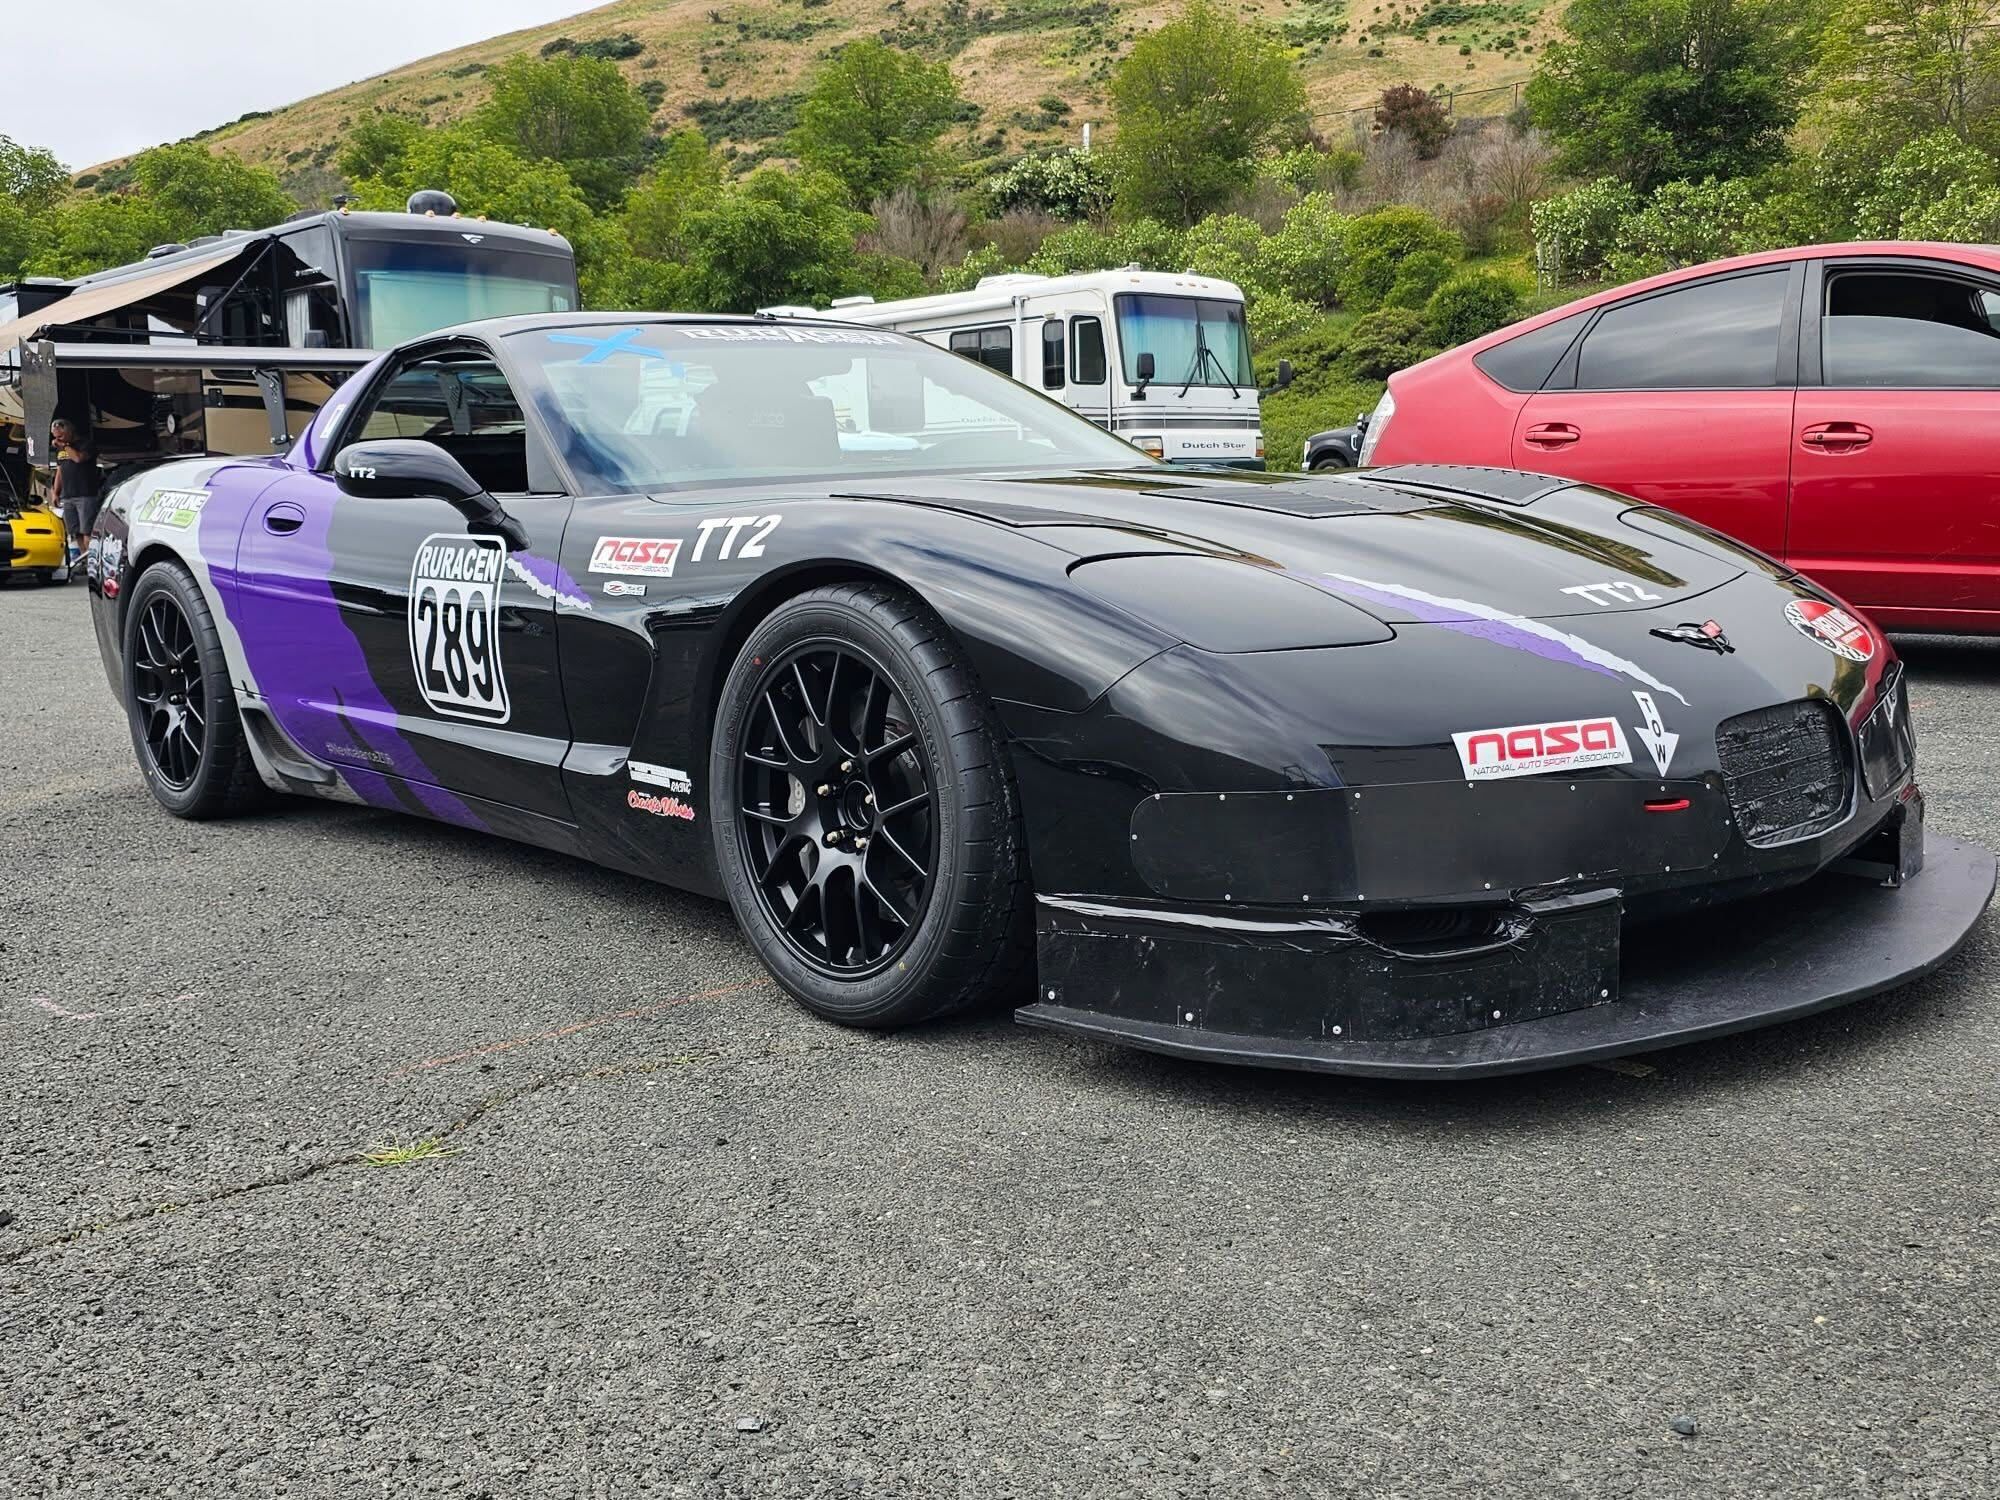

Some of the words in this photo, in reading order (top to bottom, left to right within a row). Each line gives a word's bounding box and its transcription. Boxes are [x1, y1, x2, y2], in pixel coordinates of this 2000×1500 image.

[349, 466, 376, 479] TT2
[147, 506, 176, 523] AUTO
[157, 492, 208, 512] FORTUNE
[690, 514, 783, 563] TT2
[417, 545, 502, 583] RURACEN
[1559, 581, 1663, 606] TT2
[417, 585, 495, 702] 289
[1640, 697, 1666, 764] TOW
[1472, 764, 1516, 776] NATIONAL
[1517, 760, 1541, 771] AUTO
[1543, 757, 1571, 768] SPORT
[1573, 750, 1625, 763] ASSOCIATION
